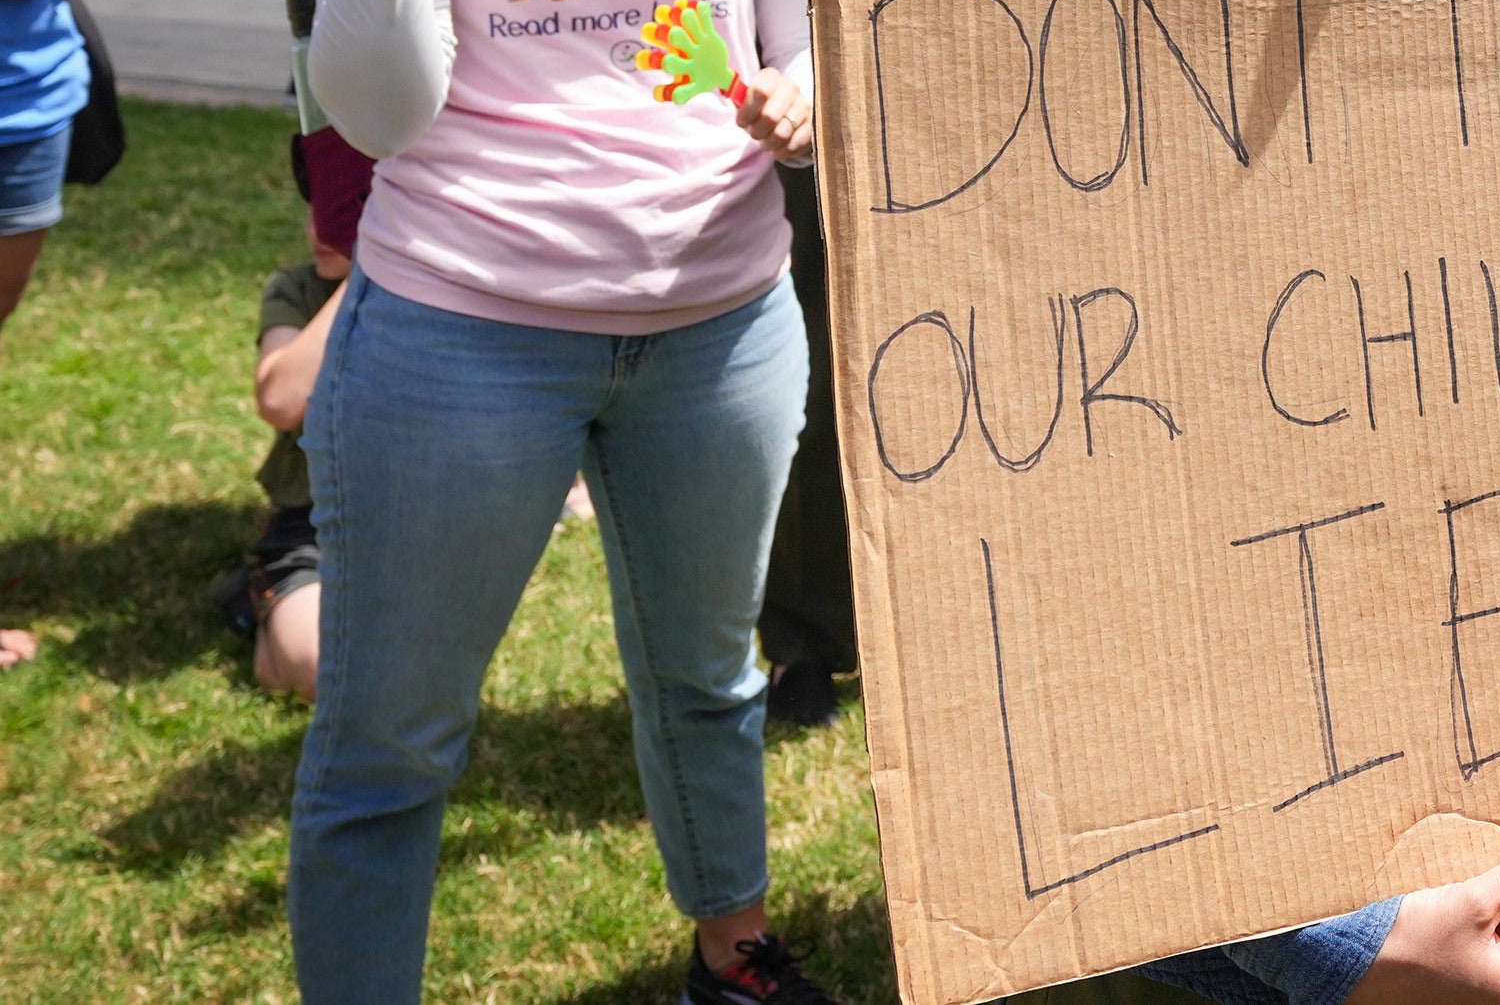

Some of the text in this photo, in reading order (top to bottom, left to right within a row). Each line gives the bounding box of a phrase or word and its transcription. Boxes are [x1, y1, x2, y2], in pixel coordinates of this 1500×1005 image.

[489, 12, 560, 38] Read
[571, 7, 640, 32] more
[868, 288, 1182, 483] OUR
